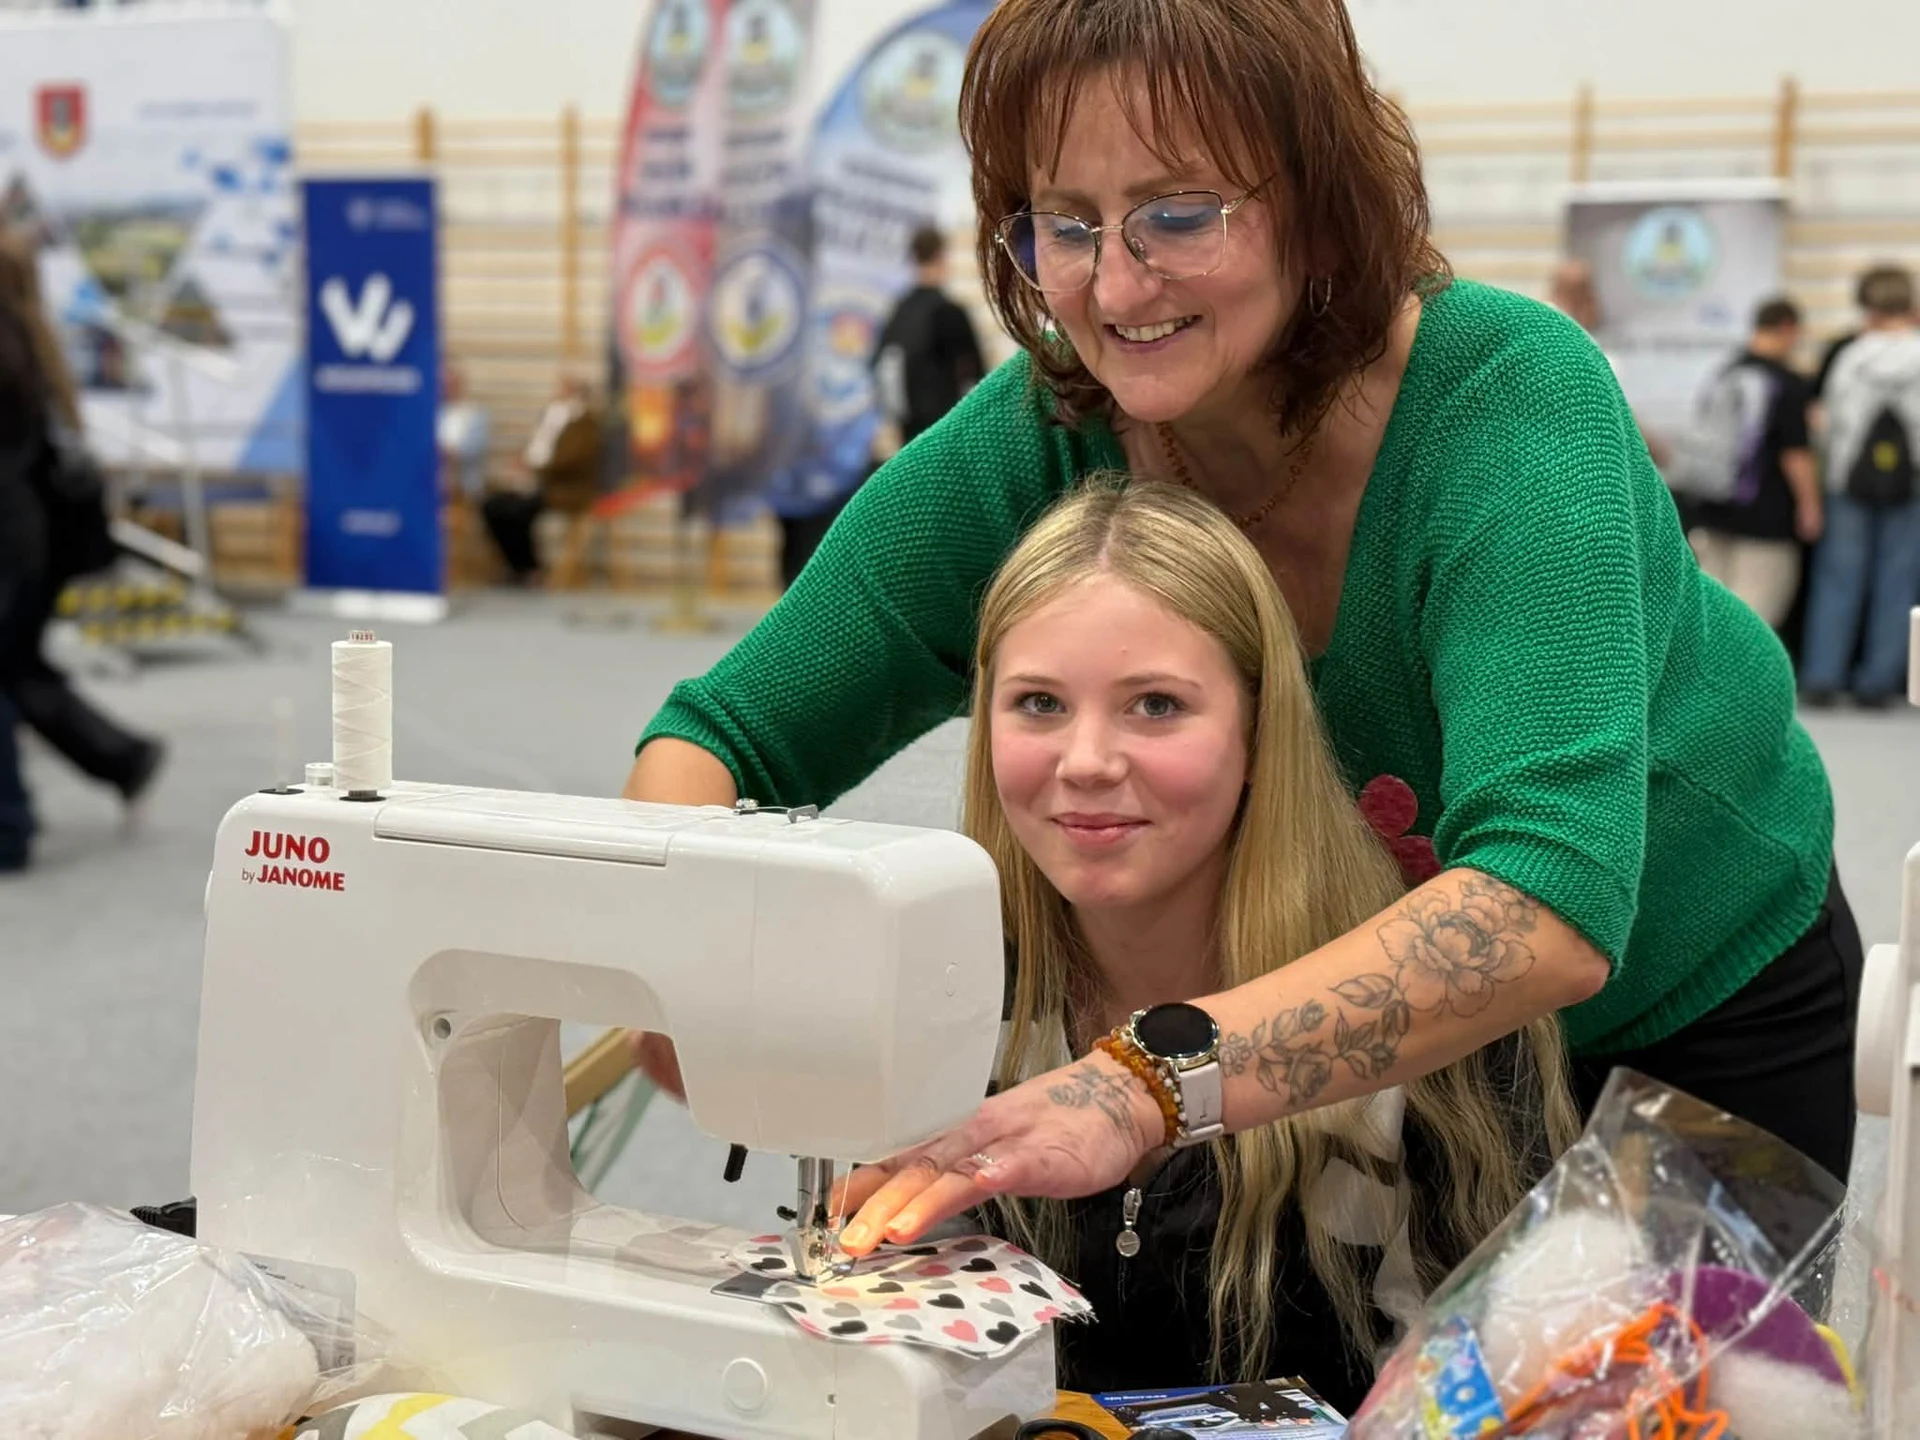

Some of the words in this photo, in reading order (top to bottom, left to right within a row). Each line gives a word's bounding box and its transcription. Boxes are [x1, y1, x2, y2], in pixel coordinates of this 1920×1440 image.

[245, 830, 330, 863] JUNO
[242, 868, 255, 884] by
[257, 864, 345, 891] JANOME
